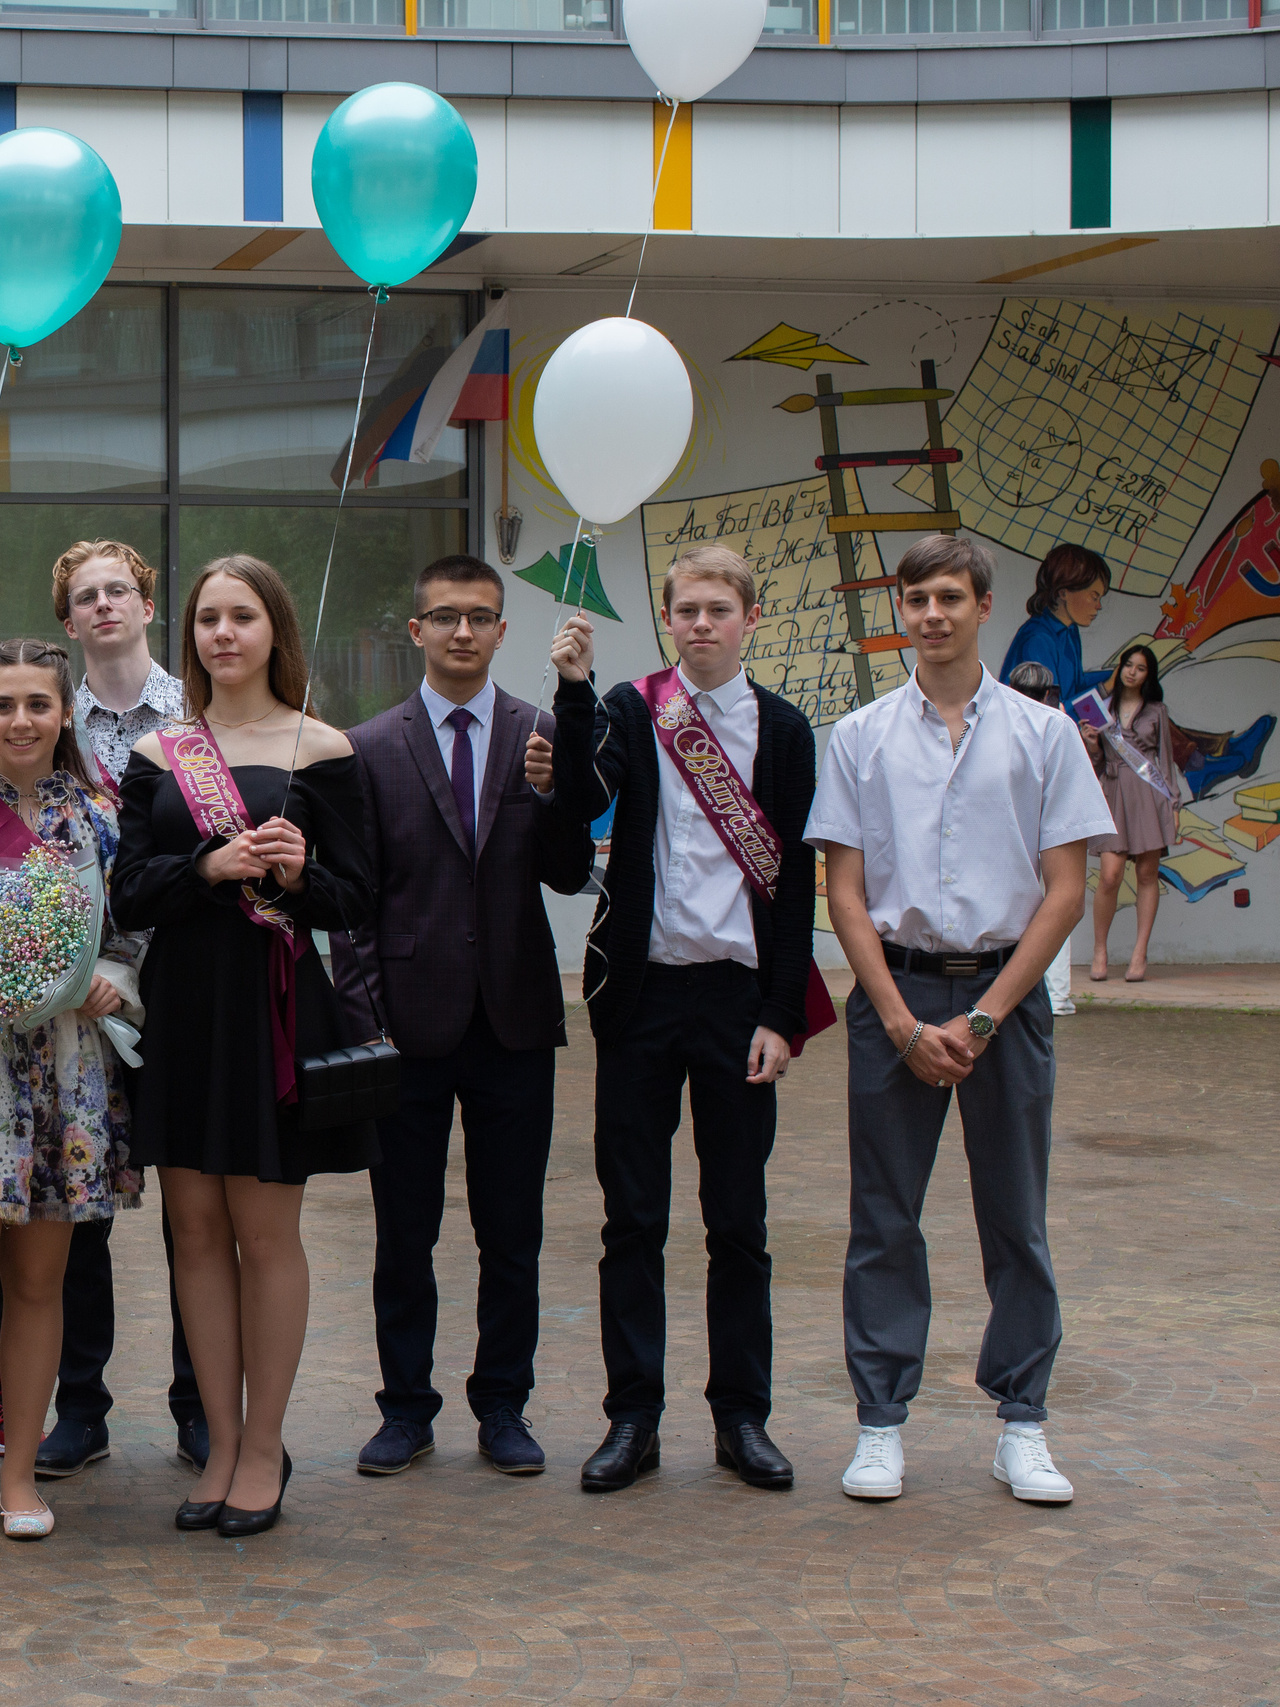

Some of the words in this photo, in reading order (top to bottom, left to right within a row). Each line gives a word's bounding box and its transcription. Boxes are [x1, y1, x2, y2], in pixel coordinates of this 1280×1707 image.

[1047, 426, 1057, 444] R
[664, 508, 707, 545] Аа
[716, 502, 760, 537] Бб
[761, 494, 795, 528] Вв
[771, 537, 828, 569] Жж
[777, 619, 804, 665] Рр
[809, 614, 834, 652] Сс
[673, 726, 781, 884] Выпускник
